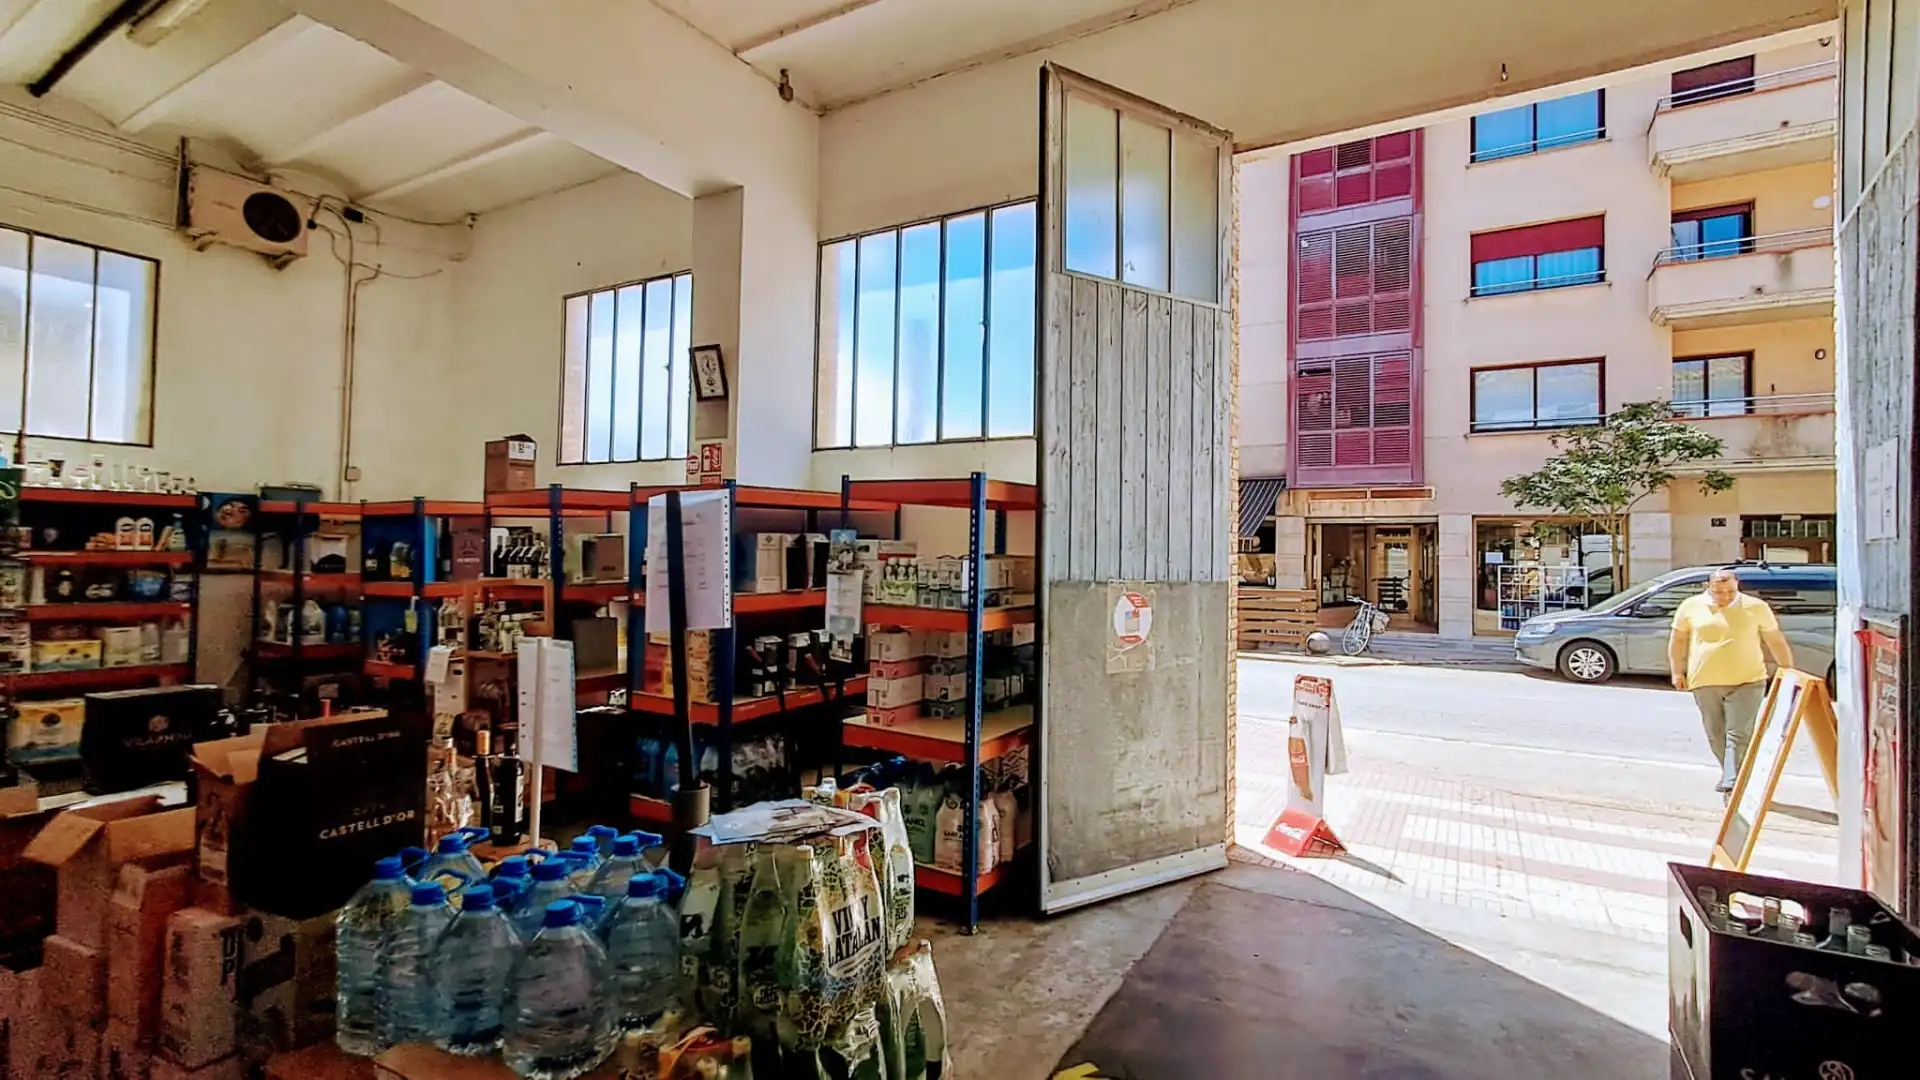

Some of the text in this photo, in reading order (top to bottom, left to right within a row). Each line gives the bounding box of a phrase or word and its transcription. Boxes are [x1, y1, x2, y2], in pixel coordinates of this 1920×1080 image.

[318, 809, 416, 840] CASTELL D'OR
[832, 894, 868, 936] VIY
[827, 916, 881, 968] CATAAN
